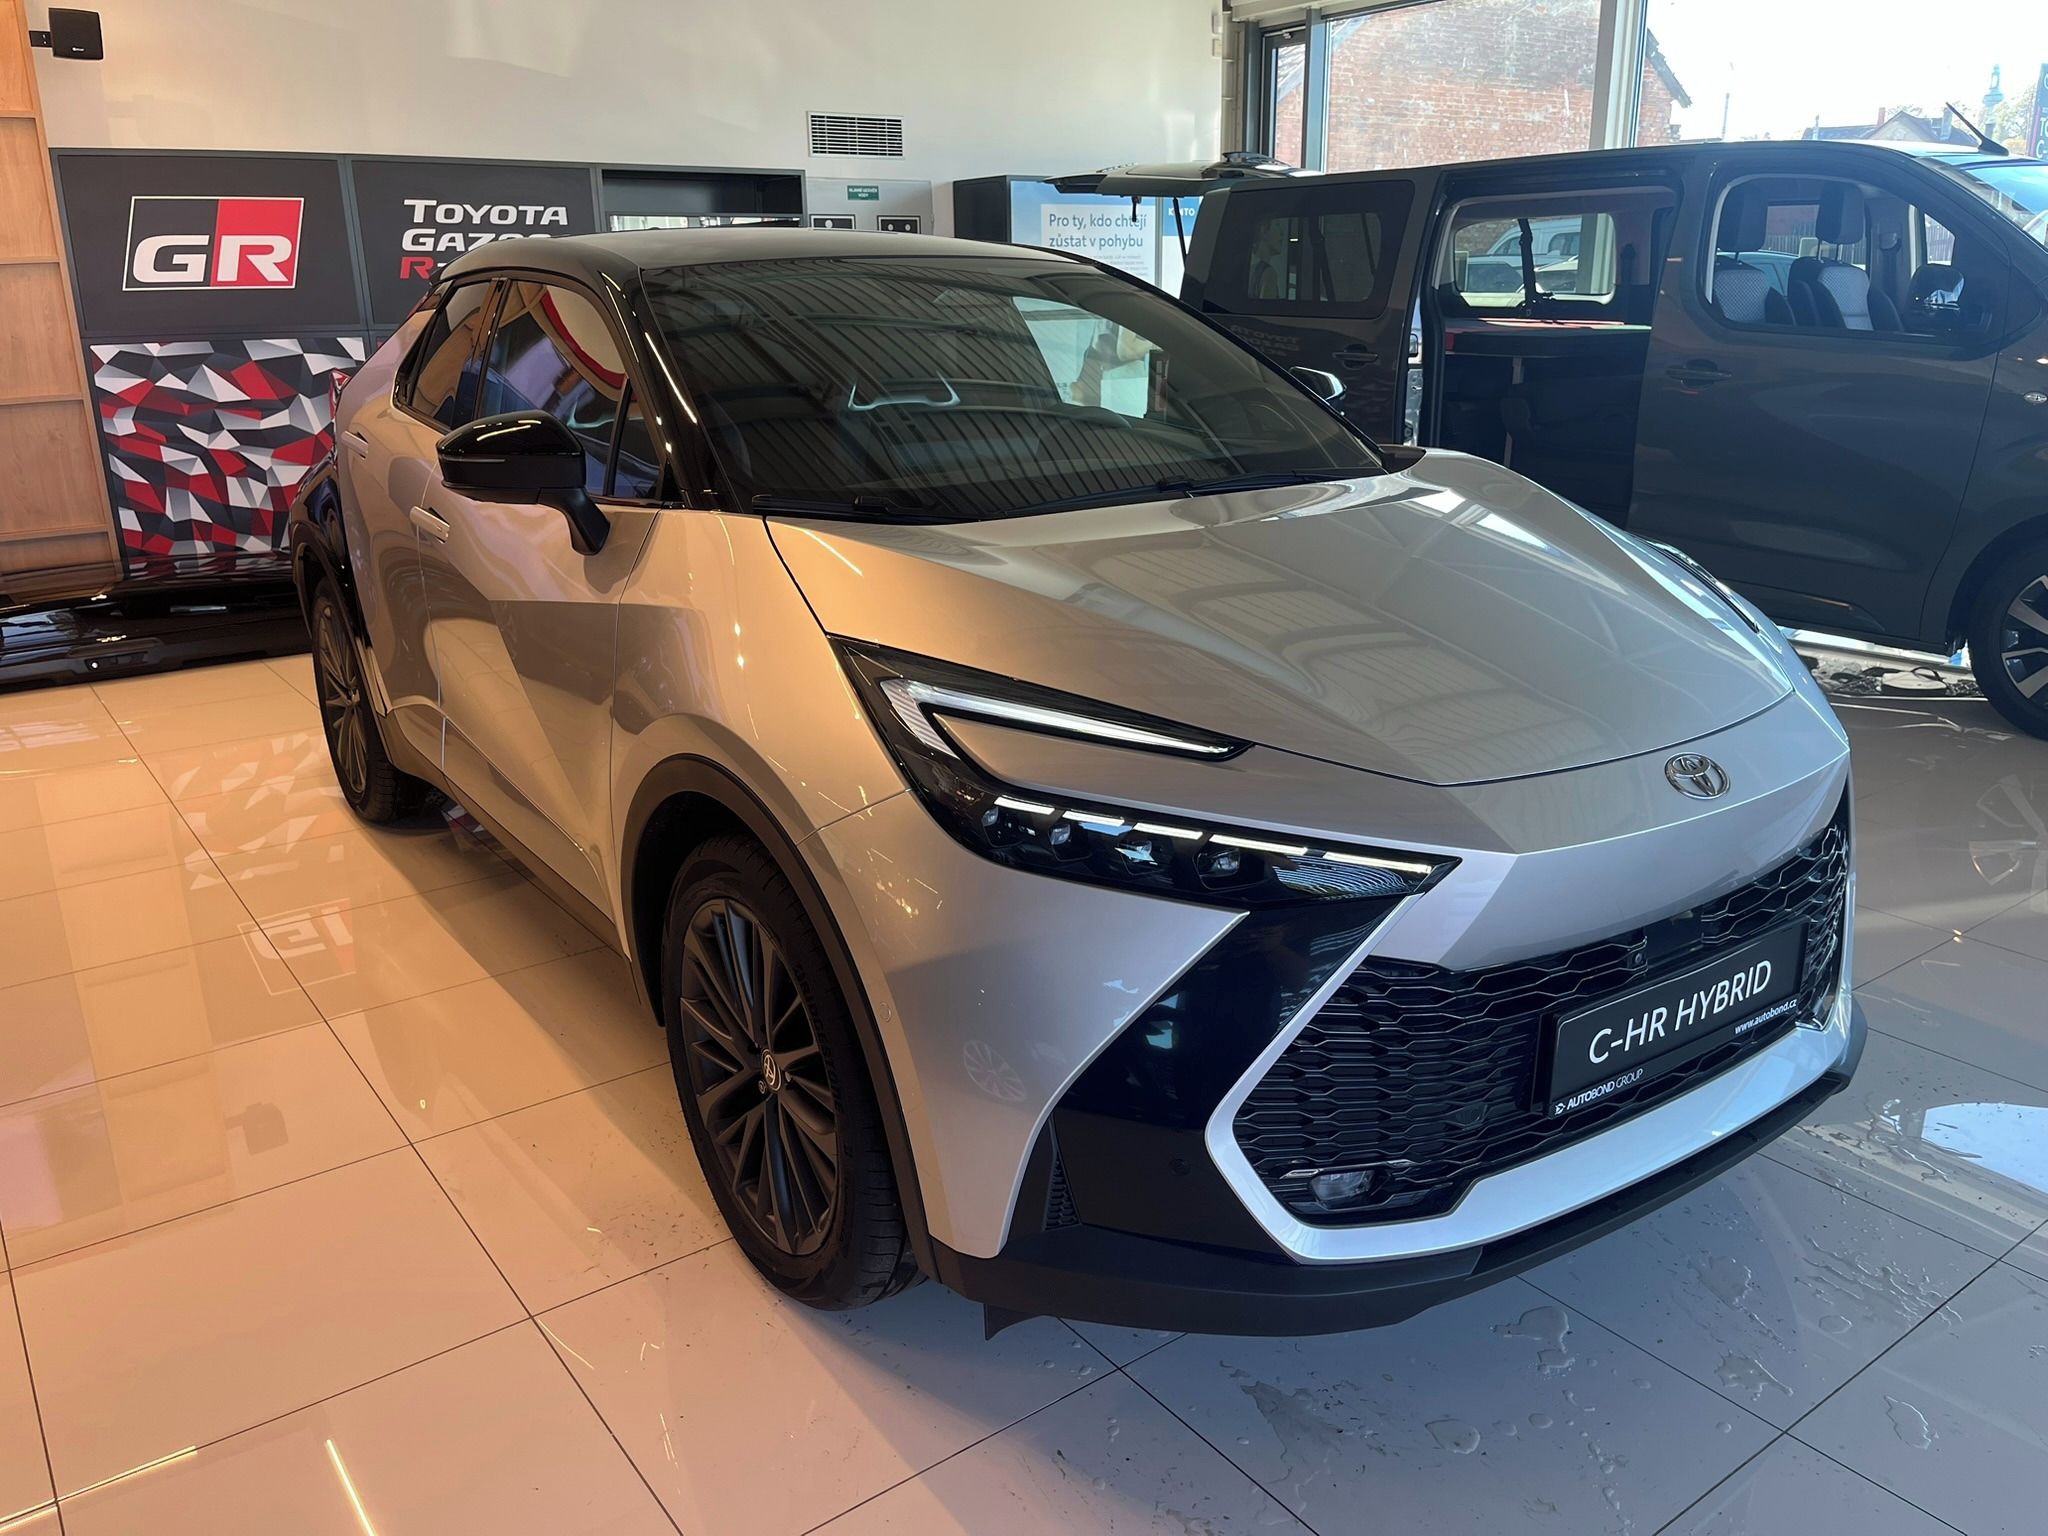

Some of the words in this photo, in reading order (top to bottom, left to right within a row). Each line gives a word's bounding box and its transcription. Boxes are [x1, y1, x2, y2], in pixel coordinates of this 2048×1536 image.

[403, 199, 568, 226] TOYOTA
[1049, 213, 1070, 227] Pro
[1072, 214, 1087, 230] ty,
[1090, 213, 1112, 227] kdo
[1168, 207, 1195, 217] KNTO
[402, 228, 552, 252] GAZ
[1049, 233, 1087, 248] zůstat
[1089, 237, 1096, 247] v
[1099, 233, 1143, 251] pohybu
[132, 234, 293, 283] GR
[1589, 1007, 1668, 1064] C-HR
[1674, 960, 1772, 1032] HYBRID
[1734, 999, 1798, 1035] www.autobond.cz
[1566, 1081, 1615, 1110] AUTOBOND
[1616, 1068, 1644, 1088] GROUP
